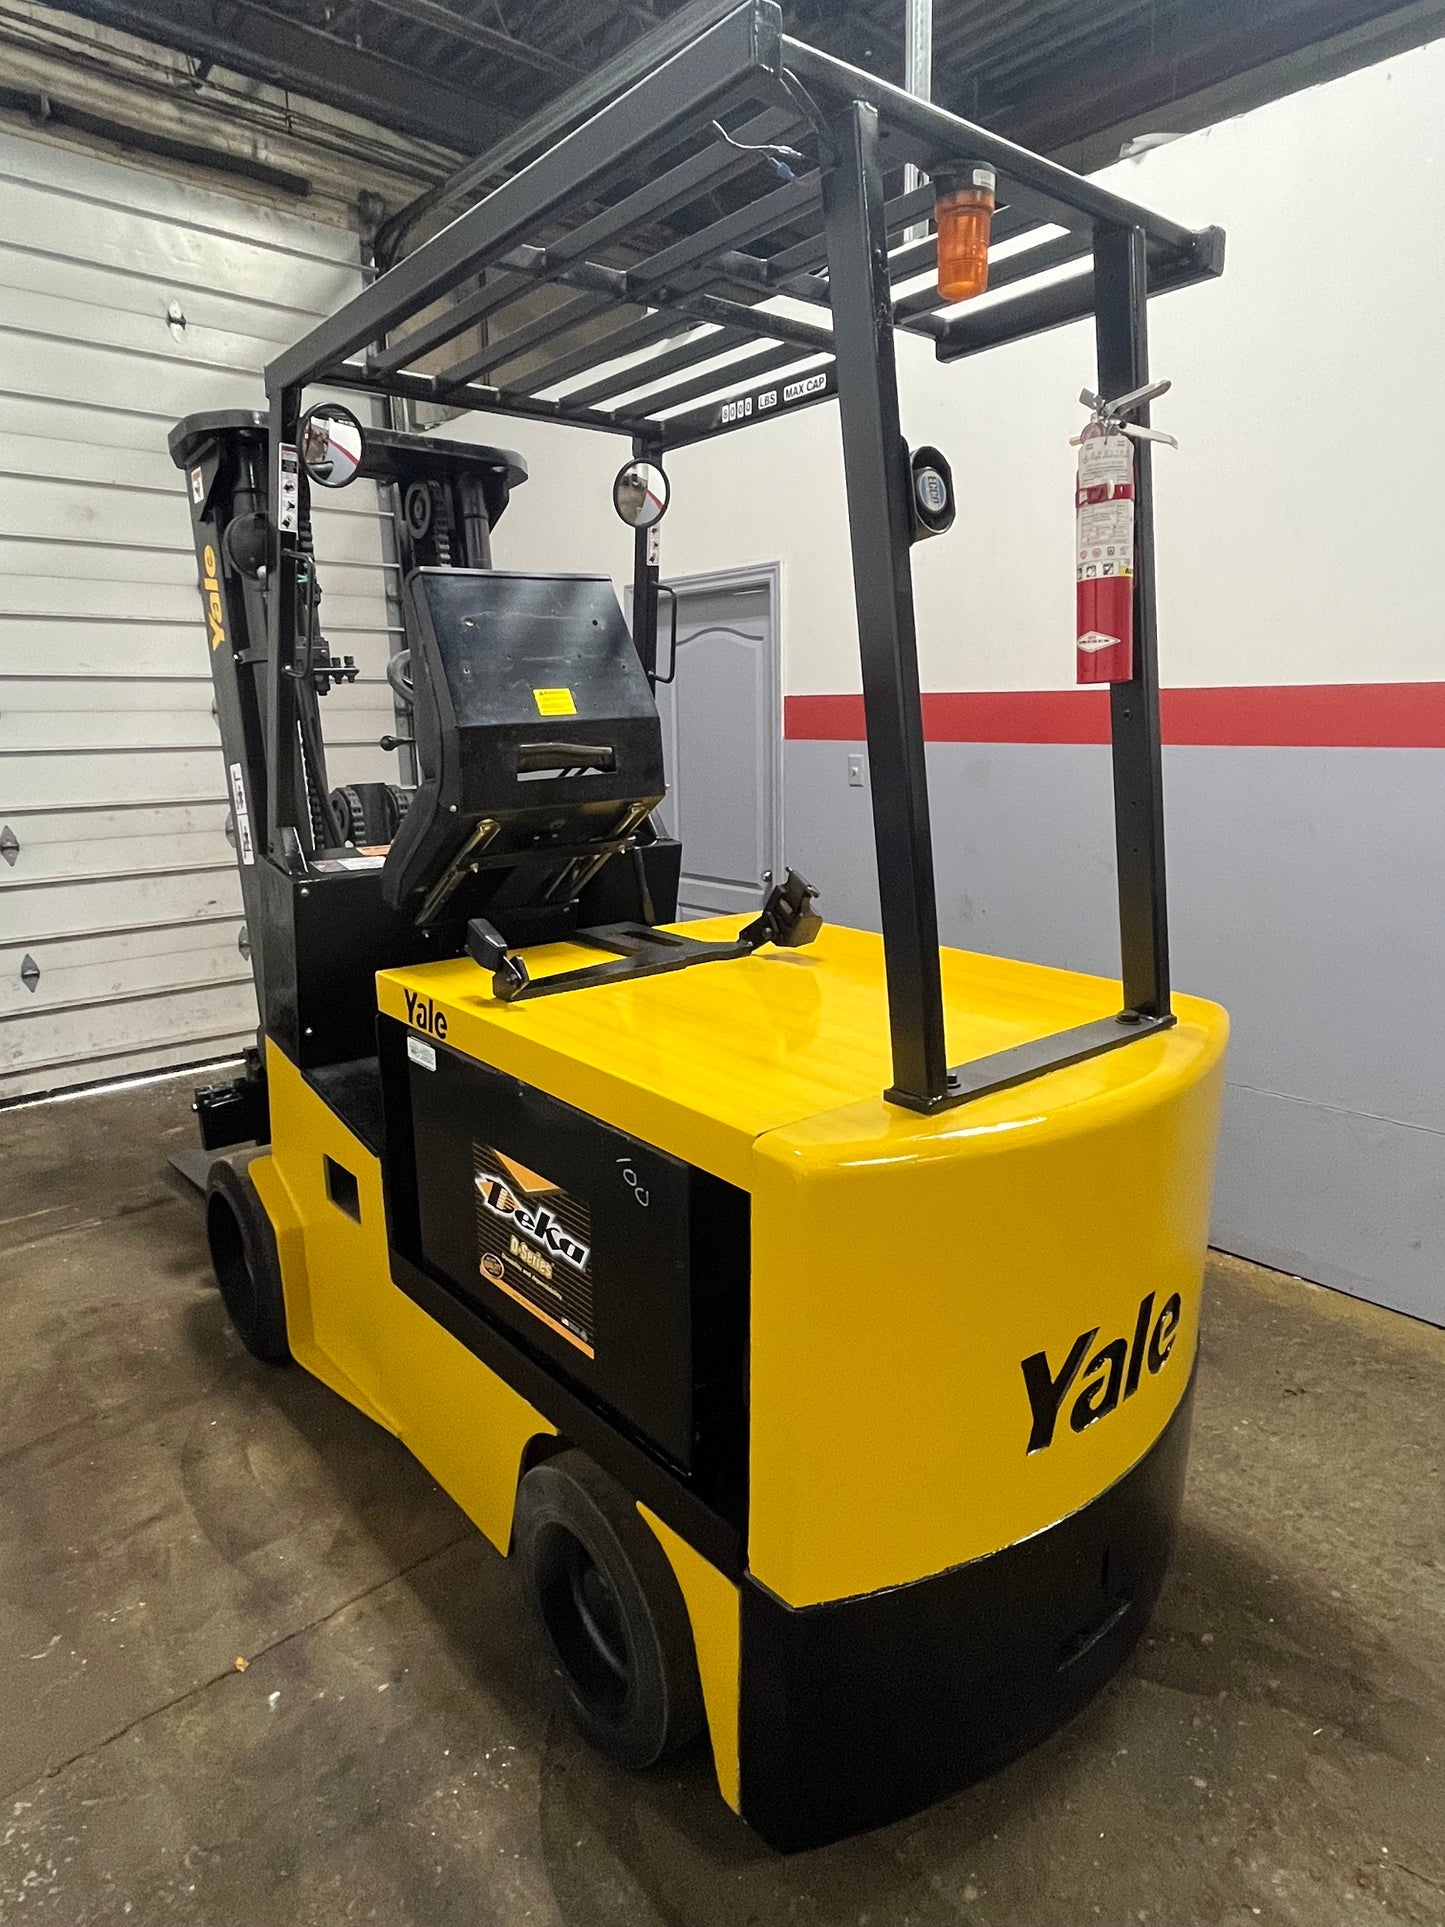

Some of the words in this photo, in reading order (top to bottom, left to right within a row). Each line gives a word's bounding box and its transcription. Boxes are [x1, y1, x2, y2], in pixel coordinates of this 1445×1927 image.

[722, 400, 751, 420] 8000
[759, 393, 776, 408] LBS
[785, 384, 804, 399] MAX
[806, 376, 825, 392] CAP
[203, 544, 226, 652] Yale
[403, 988, 448, 1040] Yale
[478, 1173, 589, 1269] Deka
[1020, 1290, 1182, 1457] Yale
